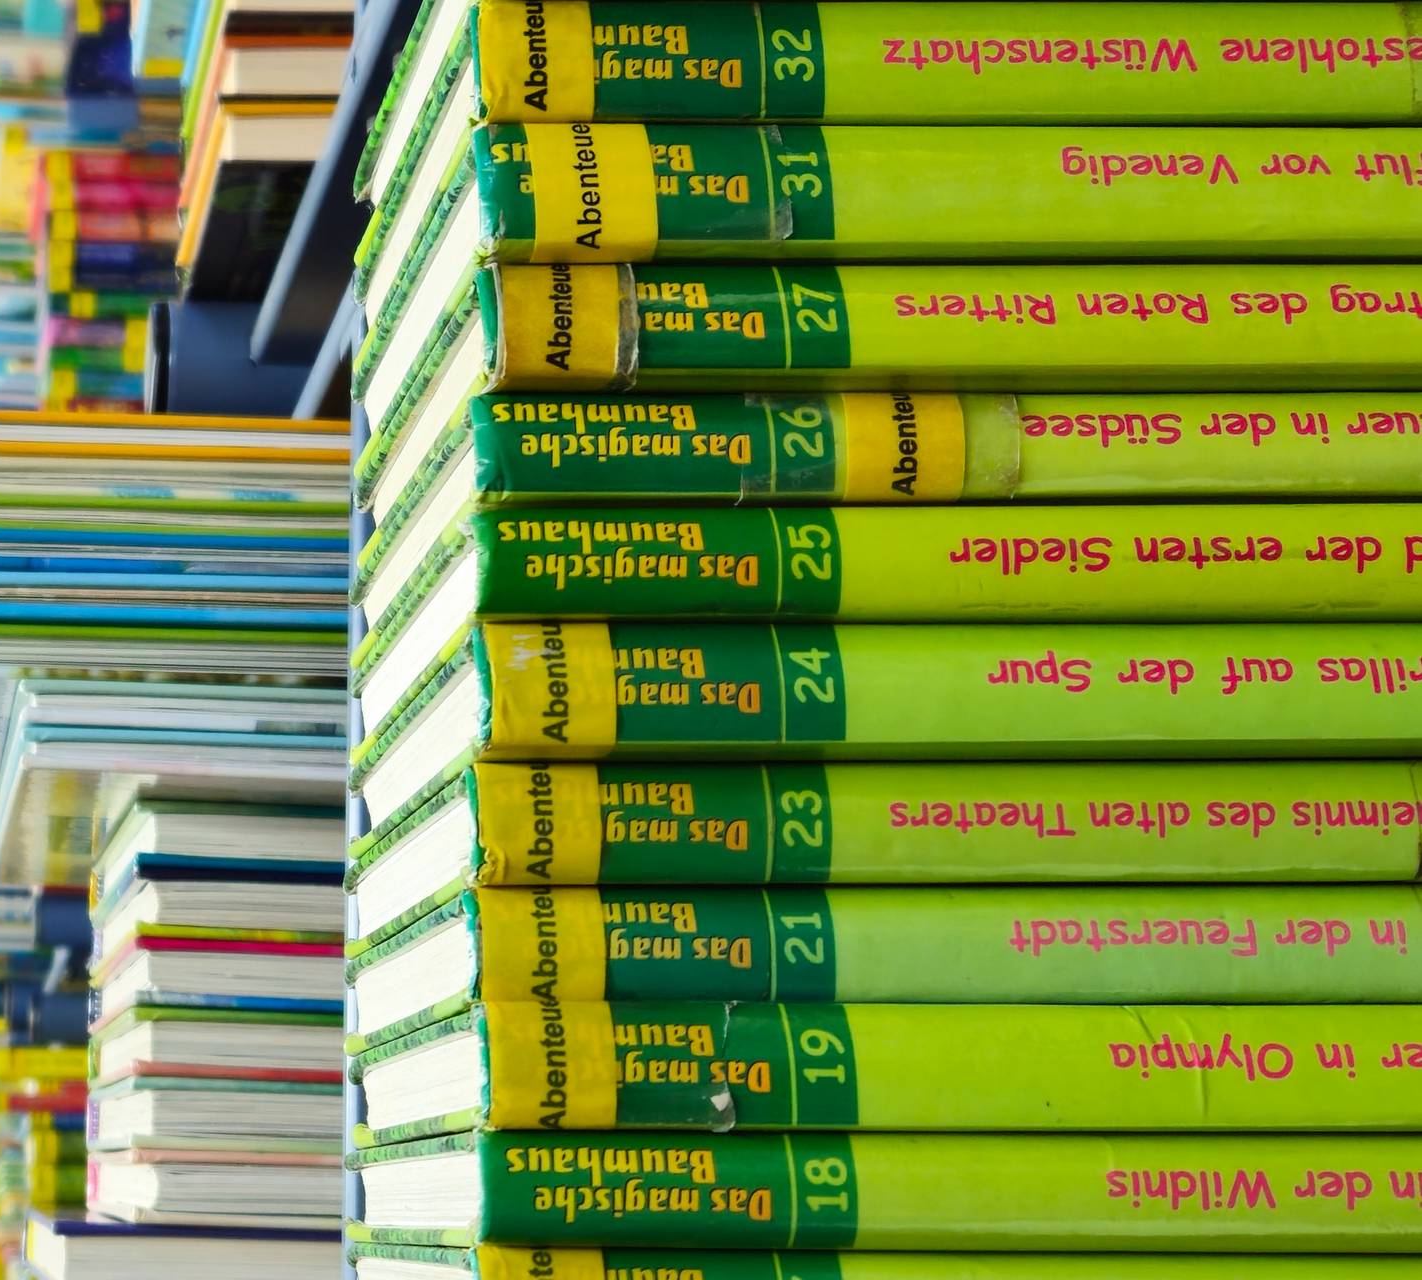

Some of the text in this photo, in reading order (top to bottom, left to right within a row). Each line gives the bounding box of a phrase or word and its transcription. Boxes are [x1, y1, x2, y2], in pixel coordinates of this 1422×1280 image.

[522, 0, 550, 111] Abenteu
[595, 48, 741, 87] Das magi
[772, 30, 814, 81] 32
[882, 37, 1422, 75] estohlene Wüstenschatz
[778, 152, 822, 197] 31
[1060, 145, 1422, 187] lut vor Venedig
[572, 124, 601, 250] Abenteue
[689, 176, 748, 202] Das
[544, 265, 574, 371] Abenteue
[705, 312, 765, 338] Das
[791, 282, 838, 333] 27
[894, 294, 1057, 326] Ritters
[1076, 292, 1210, 325] Roten
[1229, 292, 1308, 325] des
[493, 404, 695, 434] Baumhaus
[781, 408, 823, 456] 26
[1020, 411, 1422, 448] uer in der Südsee
[522, 426, 751, 467] Das magische
[498, 521, 703, 553] Baumhaus
[787, 525, 831, 579] 25
[949, 535, 1422, 576] d der ersten Siedler
[527, 546, 757, 589] Das magische
[540, 624, 572, 743] Abenteu
[788, 648, 835, 703] 24
[987, 650, 1091, 693] Spur
[1117, 659, 1195, 694] der
[1221, 656, 1293, 695] auf
[701, 683, 760, 712] Das
[690, 820, 747, 849] Das
[782, 791, 822, 846] 23
[889, 801, 1075, 838] Theaters
[1088, 801, 1191, 838] alten
[1206, 801, 1276, 838] des
[693, 938, 750, 967] Das
[782, 914, 823, 962] 21
[1009, 919, 1406, 956] in der Feuerstadt
[710, 1061, 770, 1092] Das
[800, 1029, 845, 1084] 19
[1109, 1033, 1422, 1081] er in Olympia
[507, 1148, 715, 1185] Baumhaus
[805, 1158, 847, 1210] 18
[536, 1176, 771, 1222] Das magische
[1106, 1169, 1276, 1210] Wildnis
[1294, 1170, 1372, 1211] der
